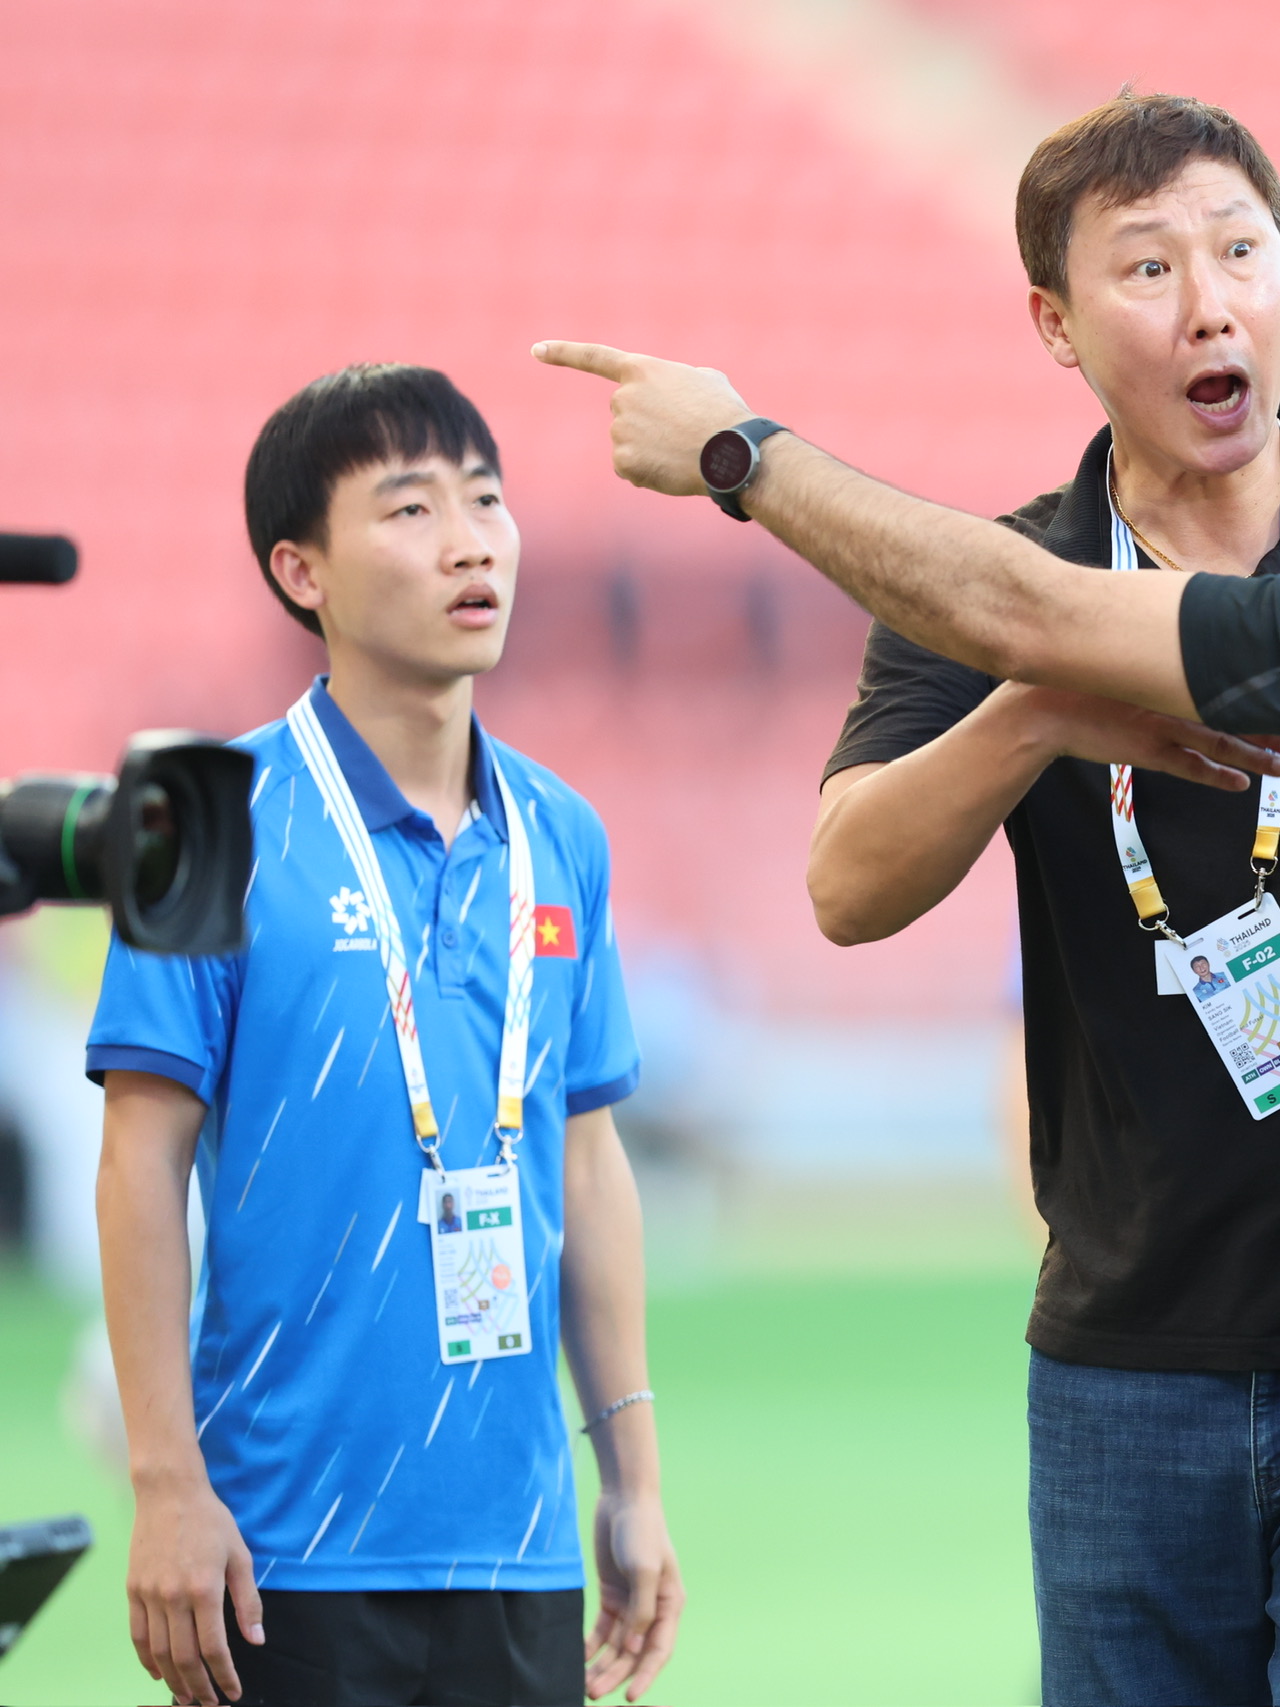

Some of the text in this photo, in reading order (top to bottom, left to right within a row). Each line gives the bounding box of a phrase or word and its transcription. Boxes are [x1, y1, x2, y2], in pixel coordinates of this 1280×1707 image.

[1229, 917, 1272, 946] THAILAND
[1242, 945, 1276, 971] F-02
[1202, 1002, 1212, 1010] KIM
[1208, 1005, 1232, 1021] SANG SIK
[1213, 1018, 1234, 1032] Vietnam
[1219, 1028, 1239, 1042] Football
[1245, 1072, 1257, 1081] ATH
[1259, 1063, 1273, 1073] OWN
[1267, 1093, 1277, 1104] S
[479, 1211, 501, 1227] F-X
